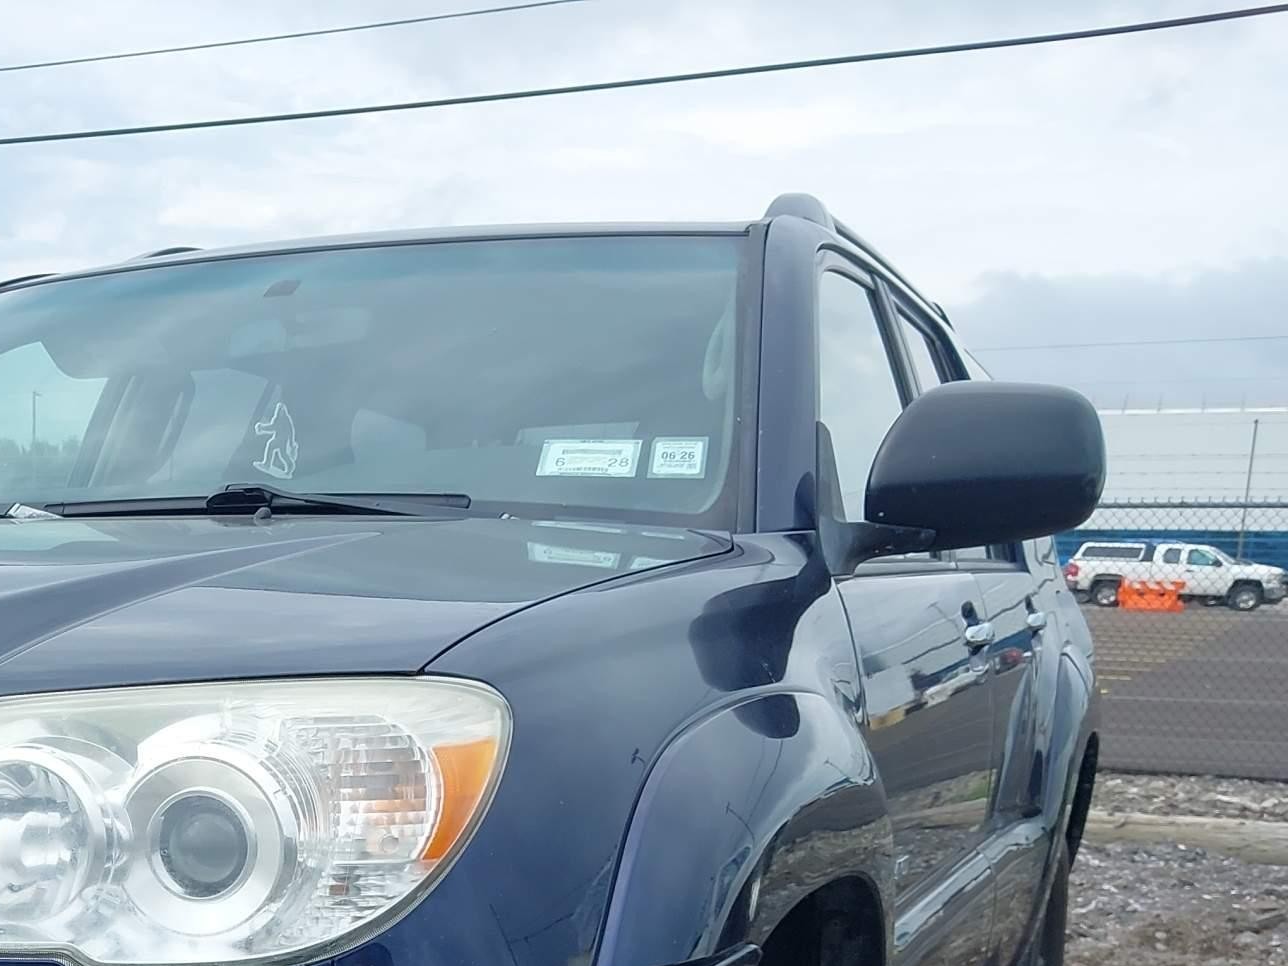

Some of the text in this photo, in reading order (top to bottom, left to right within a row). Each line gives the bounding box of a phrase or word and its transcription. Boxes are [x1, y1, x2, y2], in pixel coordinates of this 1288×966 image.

[661, 451, 696, 460] 06 26
[555, 457, 630, 468] 6 28
